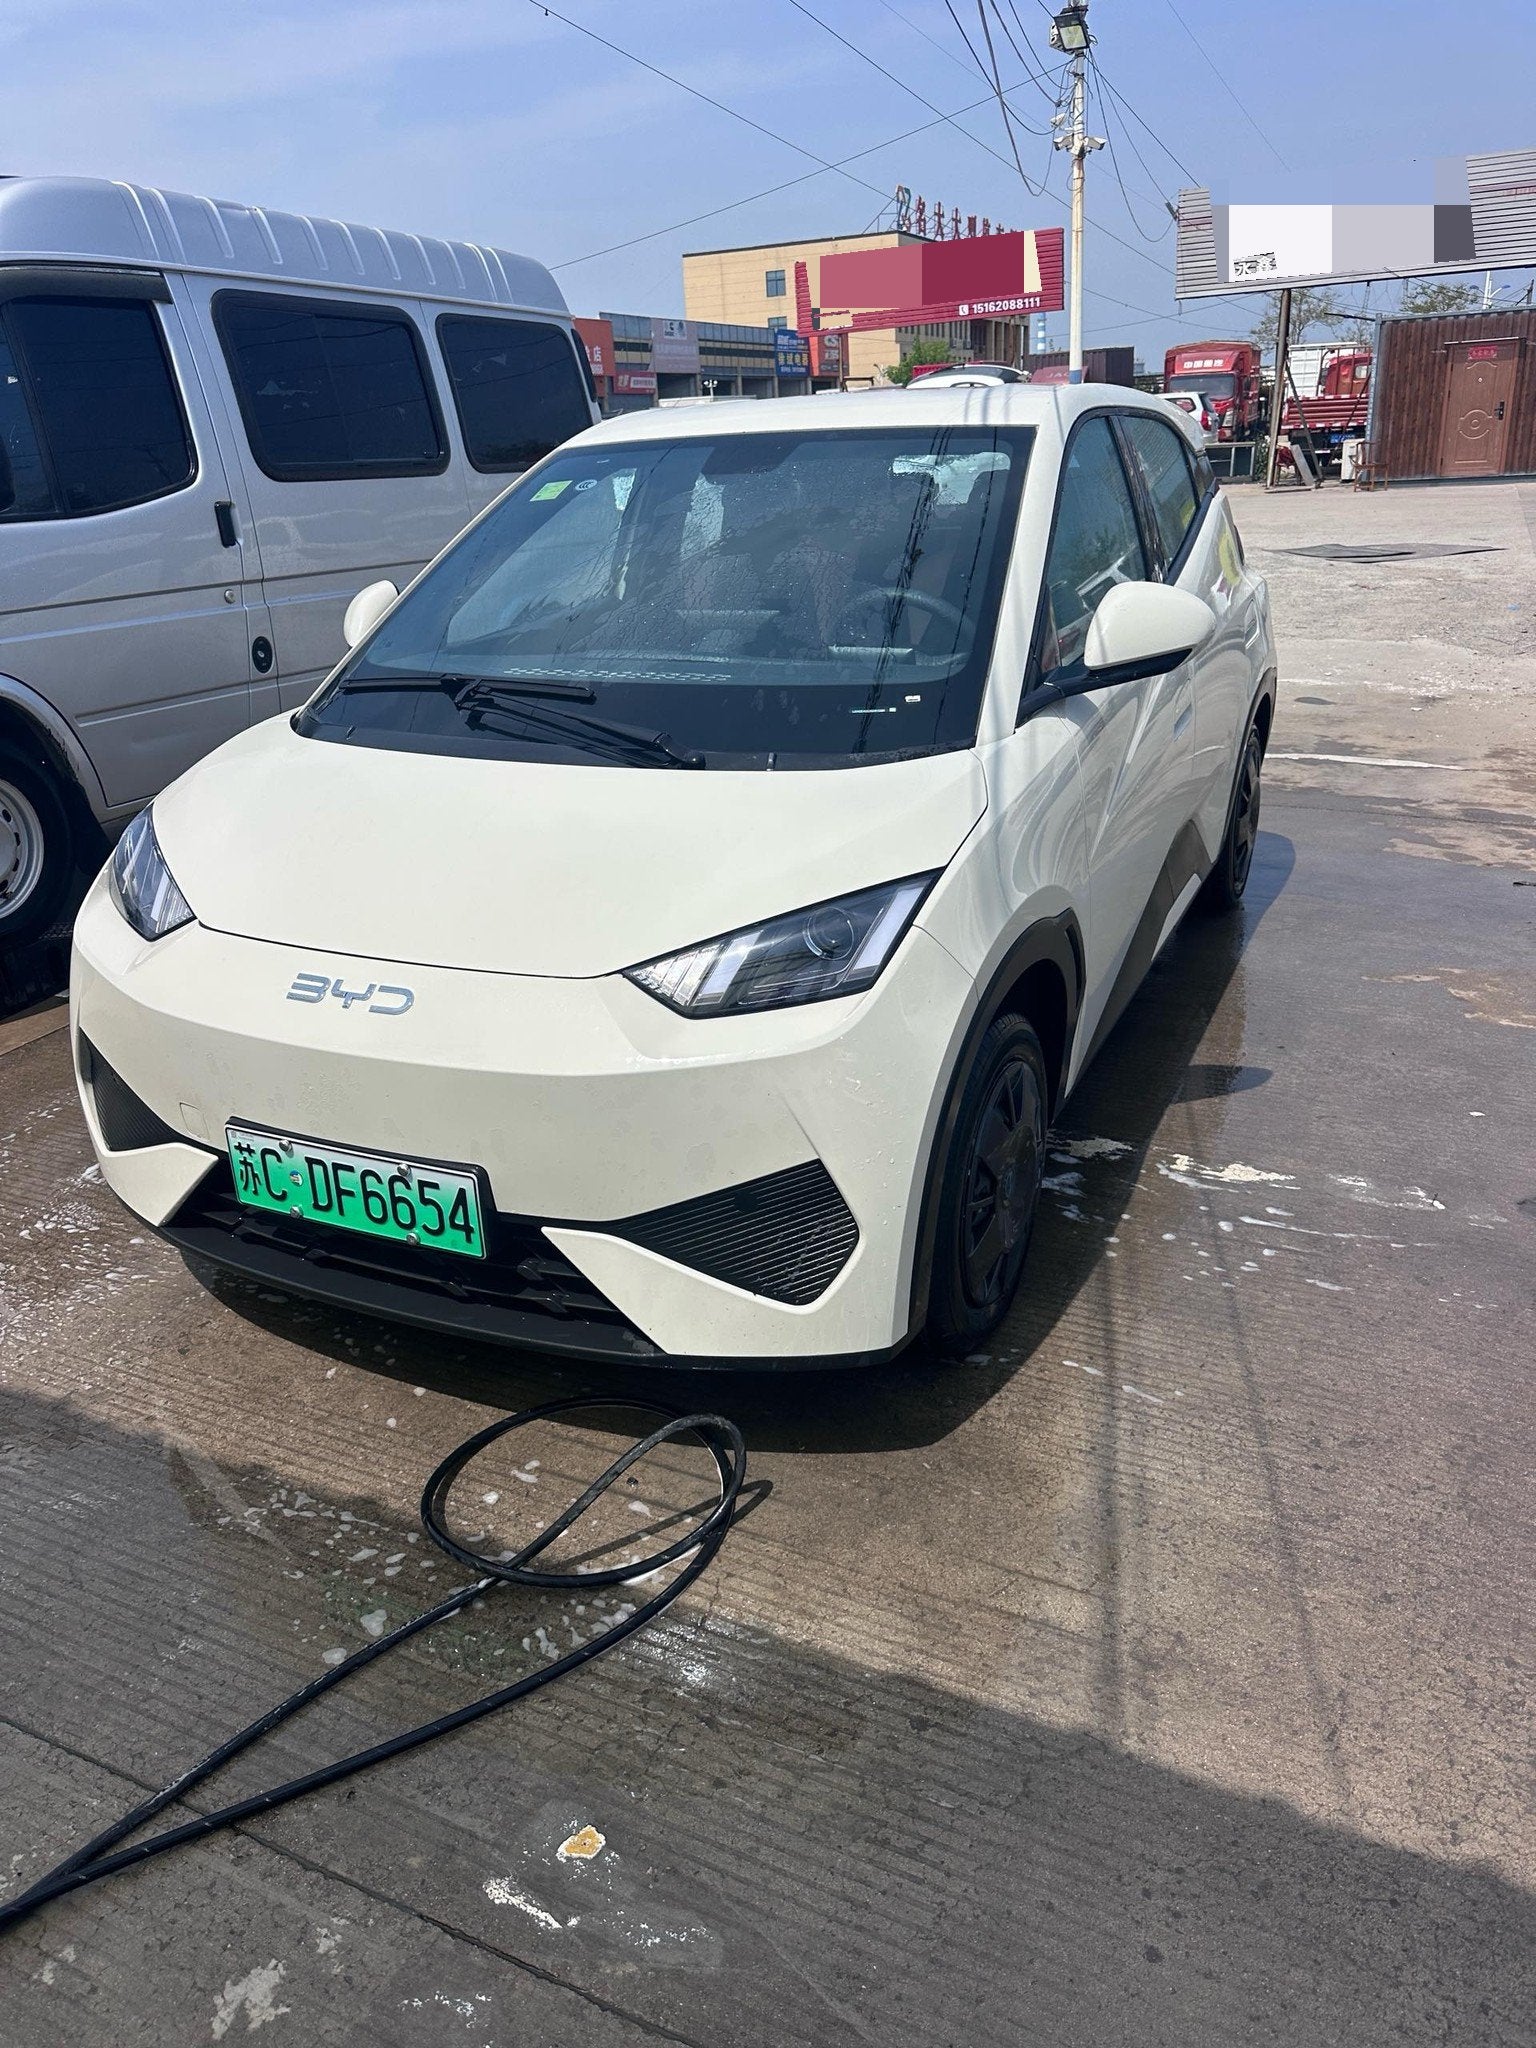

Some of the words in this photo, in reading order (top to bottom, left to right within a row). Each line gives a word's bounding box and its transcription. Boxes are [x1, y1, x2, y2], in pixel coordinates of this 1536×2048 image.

[972, 297, 1041, 314] 15162088111
[286, 972, 415, 1016] BYD
[234, 1141, 287, 1202] 苏C
[304, 1156, 474, 1244] DF6654
